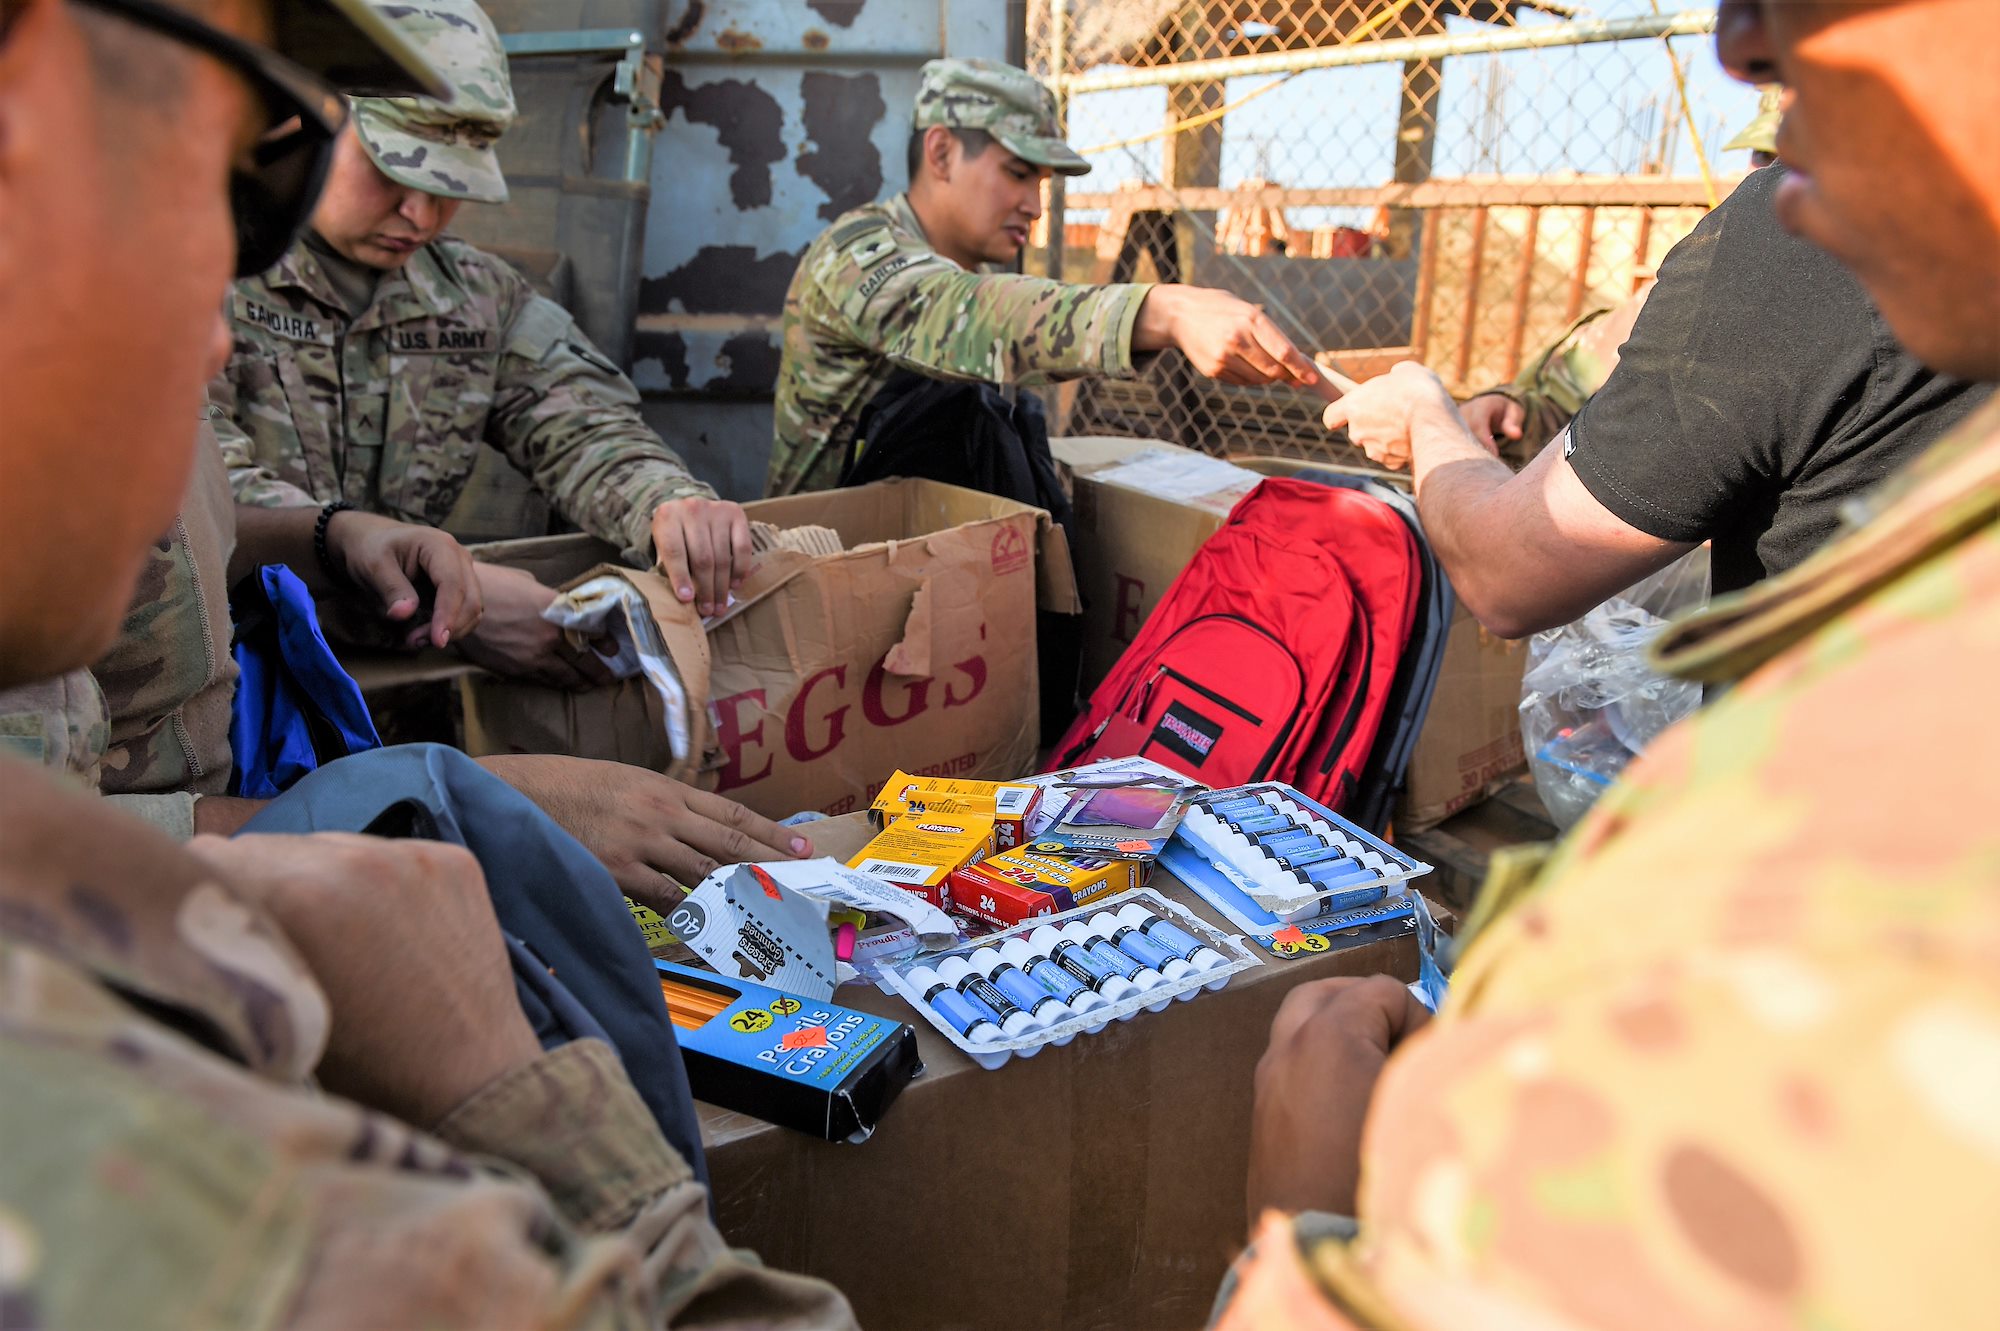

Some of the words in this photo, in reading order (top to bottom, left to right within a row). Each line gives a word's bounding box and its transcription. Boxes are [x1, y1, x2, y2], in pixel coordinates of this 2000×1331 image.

[400, 332, 431, 349] U.S.
[437, 331, 487, 349] ARMY
[908, 801, 926, 812] 24
[999, 823, 1015, 846] 24
[998, 855, 1036, 870] CRAIES
[1038, 864, 1050, 875] DE
[1049, 870, 1072, 885] CIRE
[1023, 853, 1075, 874] CRAYONS
[999, 867, 1041, 885] 24
[1072, 878, 1108, 902] CRAYONS
[979, 894, 997, 913] 24
[1386, 901, 1414, 912] Glue
[671, 909, 701, 936] 40
[744, 921, 785, 961] Gommes
[857, 930, 900, 950] Proudly
[1305, 937, 1323, 949] 8
[739, 937, 775, 976] Erasers
[732, 1009, 765, 1030] 24
[756, 1010, 831, 1064] Peils
[784, 1014, 864, 1076] Crayons
